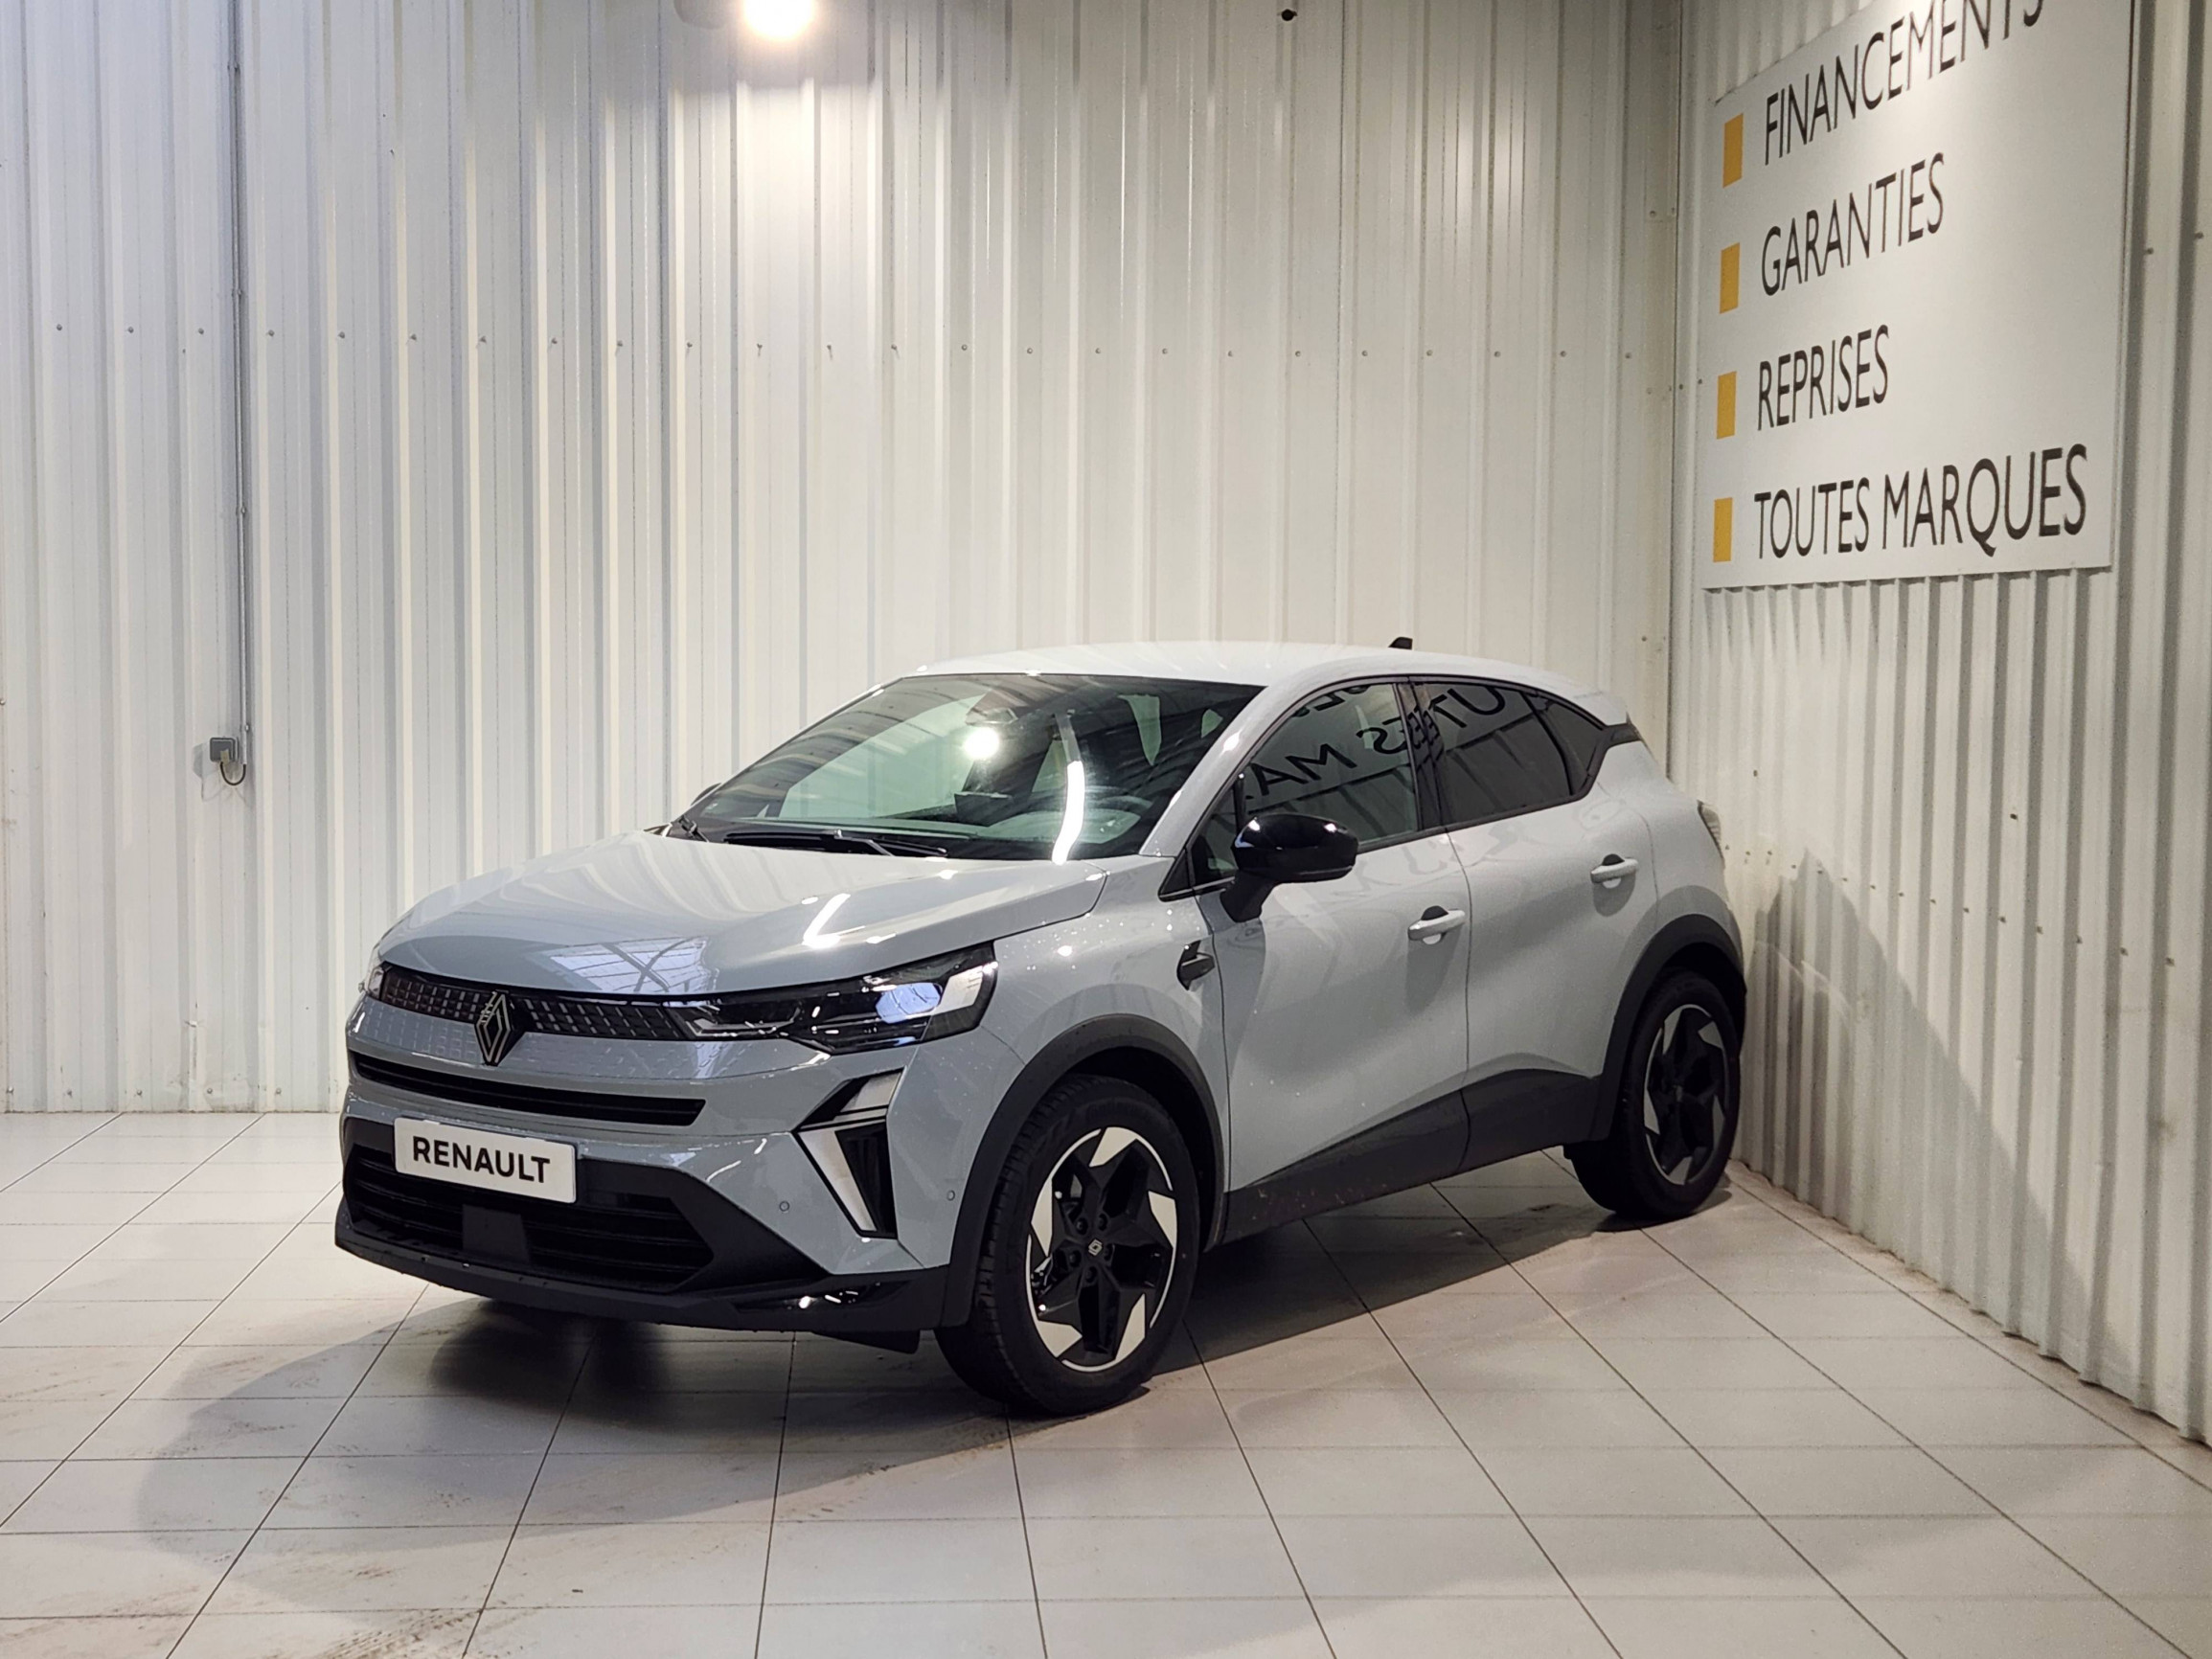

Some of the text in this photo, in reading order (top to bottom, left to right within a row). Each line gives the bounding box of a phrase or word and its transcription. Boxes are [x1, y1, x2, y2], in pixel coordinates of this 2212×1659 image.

[1765, 0, 2044, 166] FINANCEMEN
[1761, 152, 1944, 296] GARANTIES
[1758, 325, 1889, 431] REPRISES
[1754, 443, 2087, 559] TOUTES MARQUES
[412, 1135, 551, 1184] RENAULT
